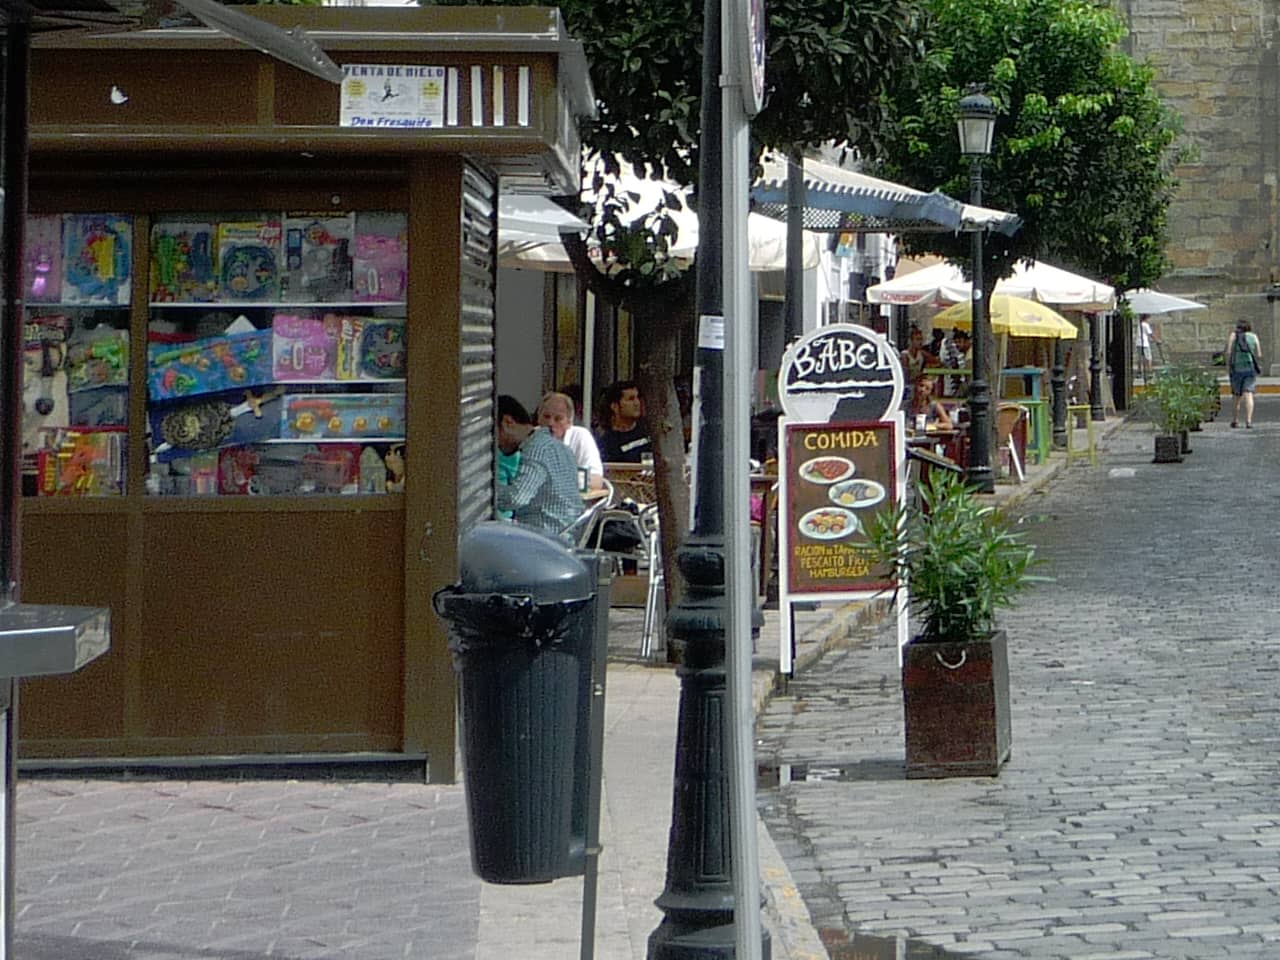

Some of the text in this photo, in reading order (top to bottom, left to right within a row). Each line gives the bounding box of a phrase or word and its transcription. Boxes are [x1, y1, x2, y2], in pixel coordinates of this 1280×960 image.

[343, 66, 384, 77] VENTA
[387, 67, 402, 77] DE
[793, 337, 894, 379] BABEL
[804, 430, 879, 450] COMIDA
